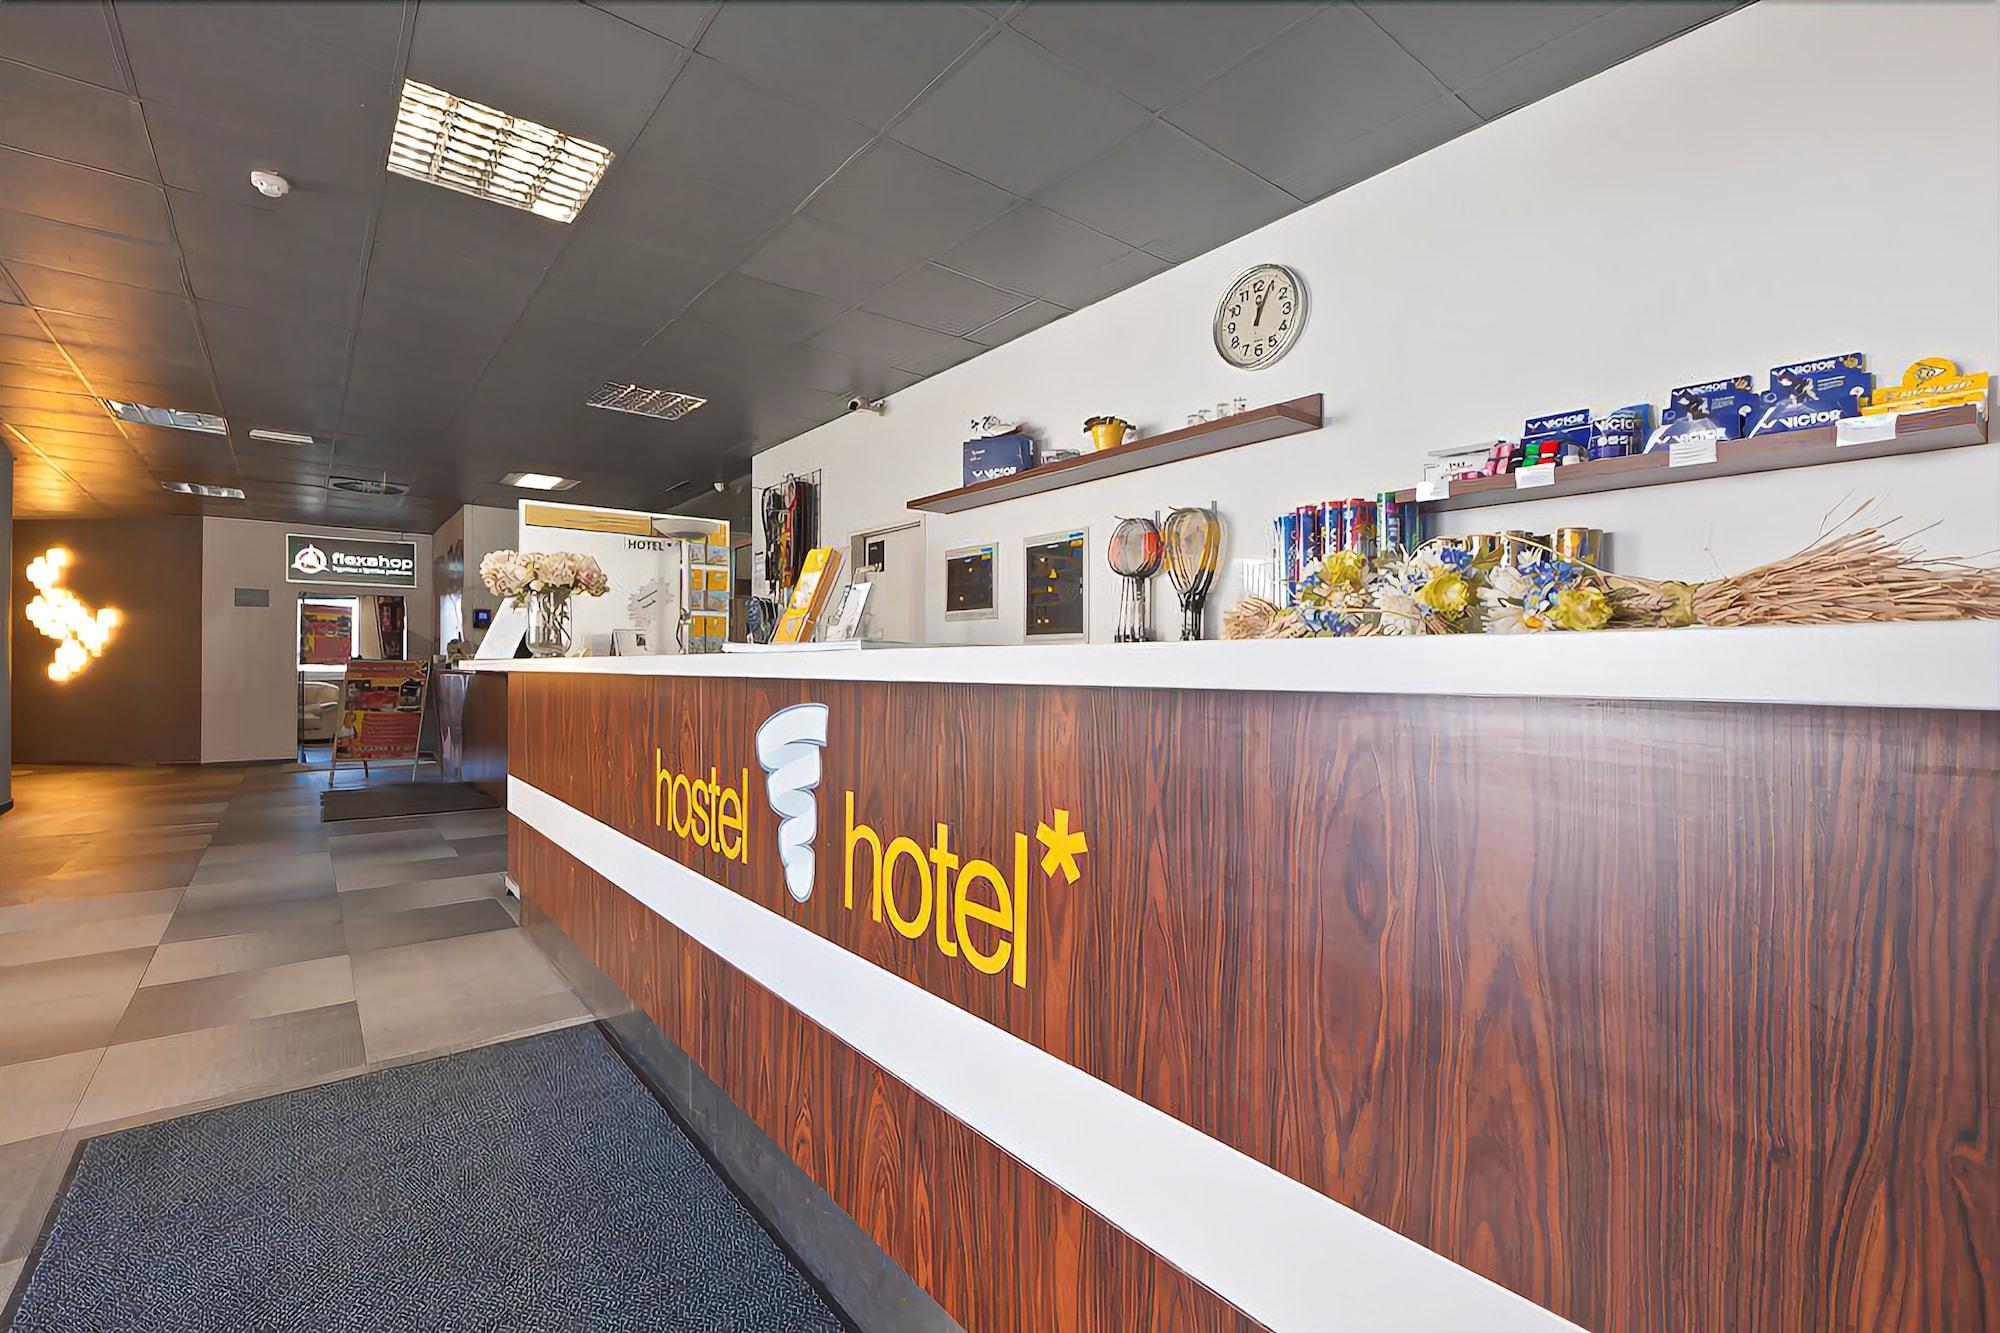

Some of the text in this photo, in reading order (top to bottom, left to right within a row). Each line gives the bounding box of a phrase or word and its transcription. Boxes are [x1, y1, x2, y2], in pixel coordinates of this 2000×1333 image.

[1253, 280, 1265, 293] 12
[1240, 291, 1249, 302] 11
[1279, 287, 1288, 300] 2
[1229, 304, 1241, 318] 10
[1282, 301, 1291, 315] 3
[1228, 322, 1236, 334] 9
[1279, 320, 1287, 331] 4
[1231, 335, 1240, 349] 8
[1268, 334, 1278, 347] 5
[1242, 344, 1250, 356] 7
[1254, 344, 1263, 356] 6
[1787, 360, 1836, 375] VICTOR
[1543, 413, 1585, 430] VICTOR
[1778, 409, 1842, 428] VICTOR
[655, 748, 749, 865] hostel
